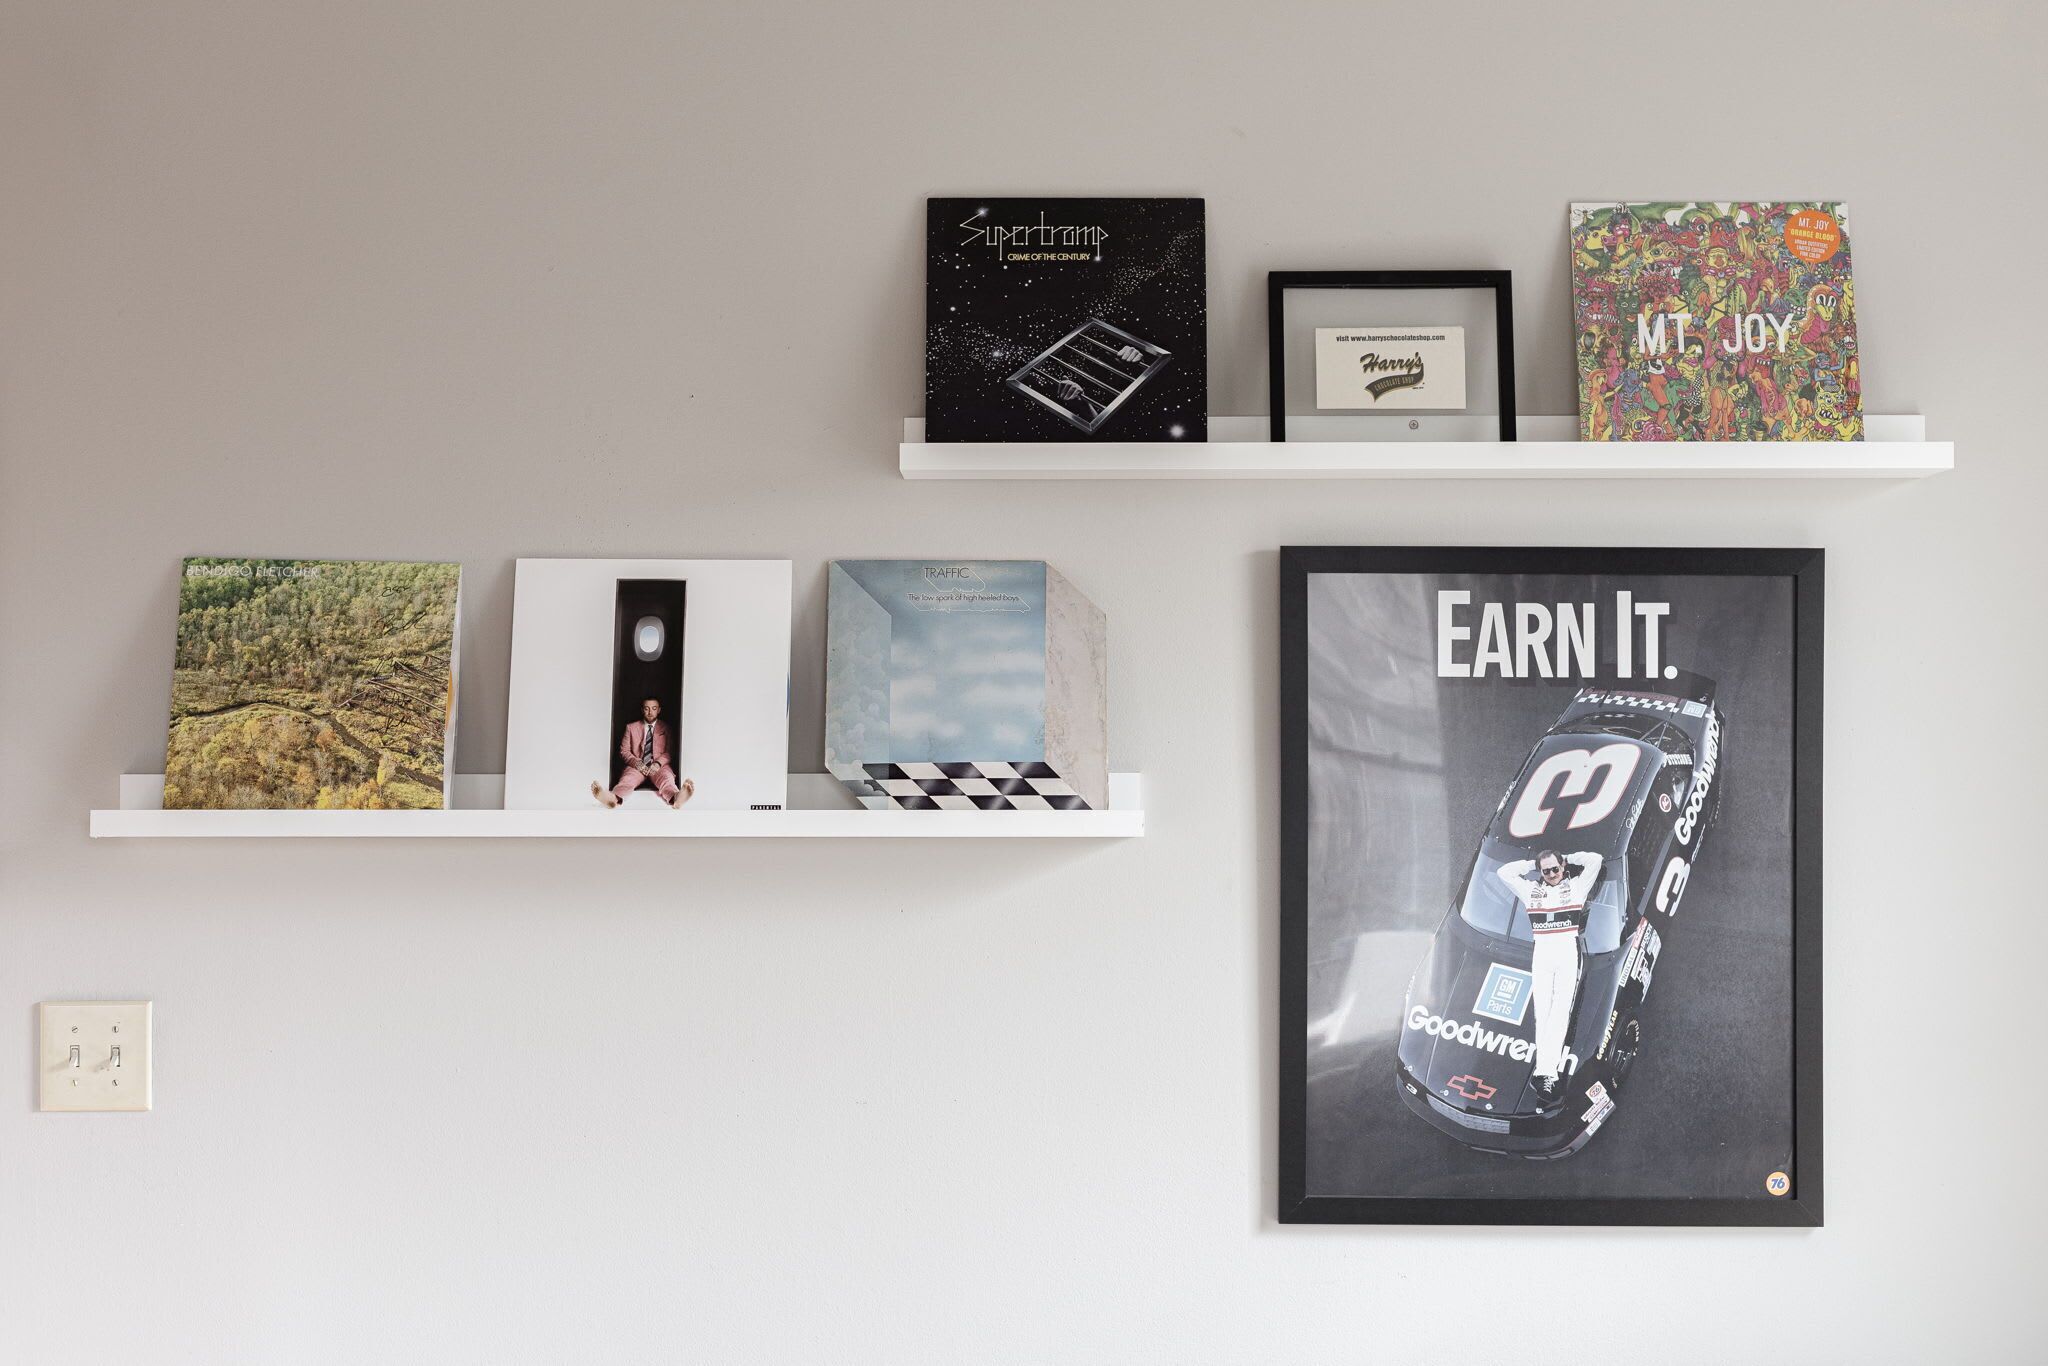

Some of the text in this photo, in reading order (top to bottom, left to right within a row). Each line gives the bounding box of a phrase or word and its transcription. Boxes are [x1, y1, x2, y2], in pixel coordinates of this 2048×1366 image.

[1813, 219, 1830, 231] JOY
[960, 210, 1109, 261] Supertramp
[1007, 252, 1091, 261] CRIME OF THE CENTURY
[1350, 334, 1446, 342] www.harryschocolateshop.com
[1637, 313, 1794, 354] MT. JOY
[1359, 351, 1422, 374] Harry's
[186, 564, 321, 578] BENDIGO FLETCHER
[924, 567, 970, 579] TRAFFIC
[908, 593, 920, 601] The
[921, 593, 935, 601] low
[935, 593, 955, 603] spark
[954, 593, 962, 601] of
[963, 593, 978, 603] high
[1002, 593, 1020, 603] boys
[1437, 590, 1596, 678] EARN
[1507, 742, 1643, 837] 3
[1656, 856, 1691, 917] 3
[1532, 919, 1573, 930] Goodwrench
[1499, 978, 1518, 994] GM
[1486, 1000, 1513, 1015] Parts
[1407, 1004, 1580, 1077] Goodwreh
[1771, 1177, 1786, 1190] 76
